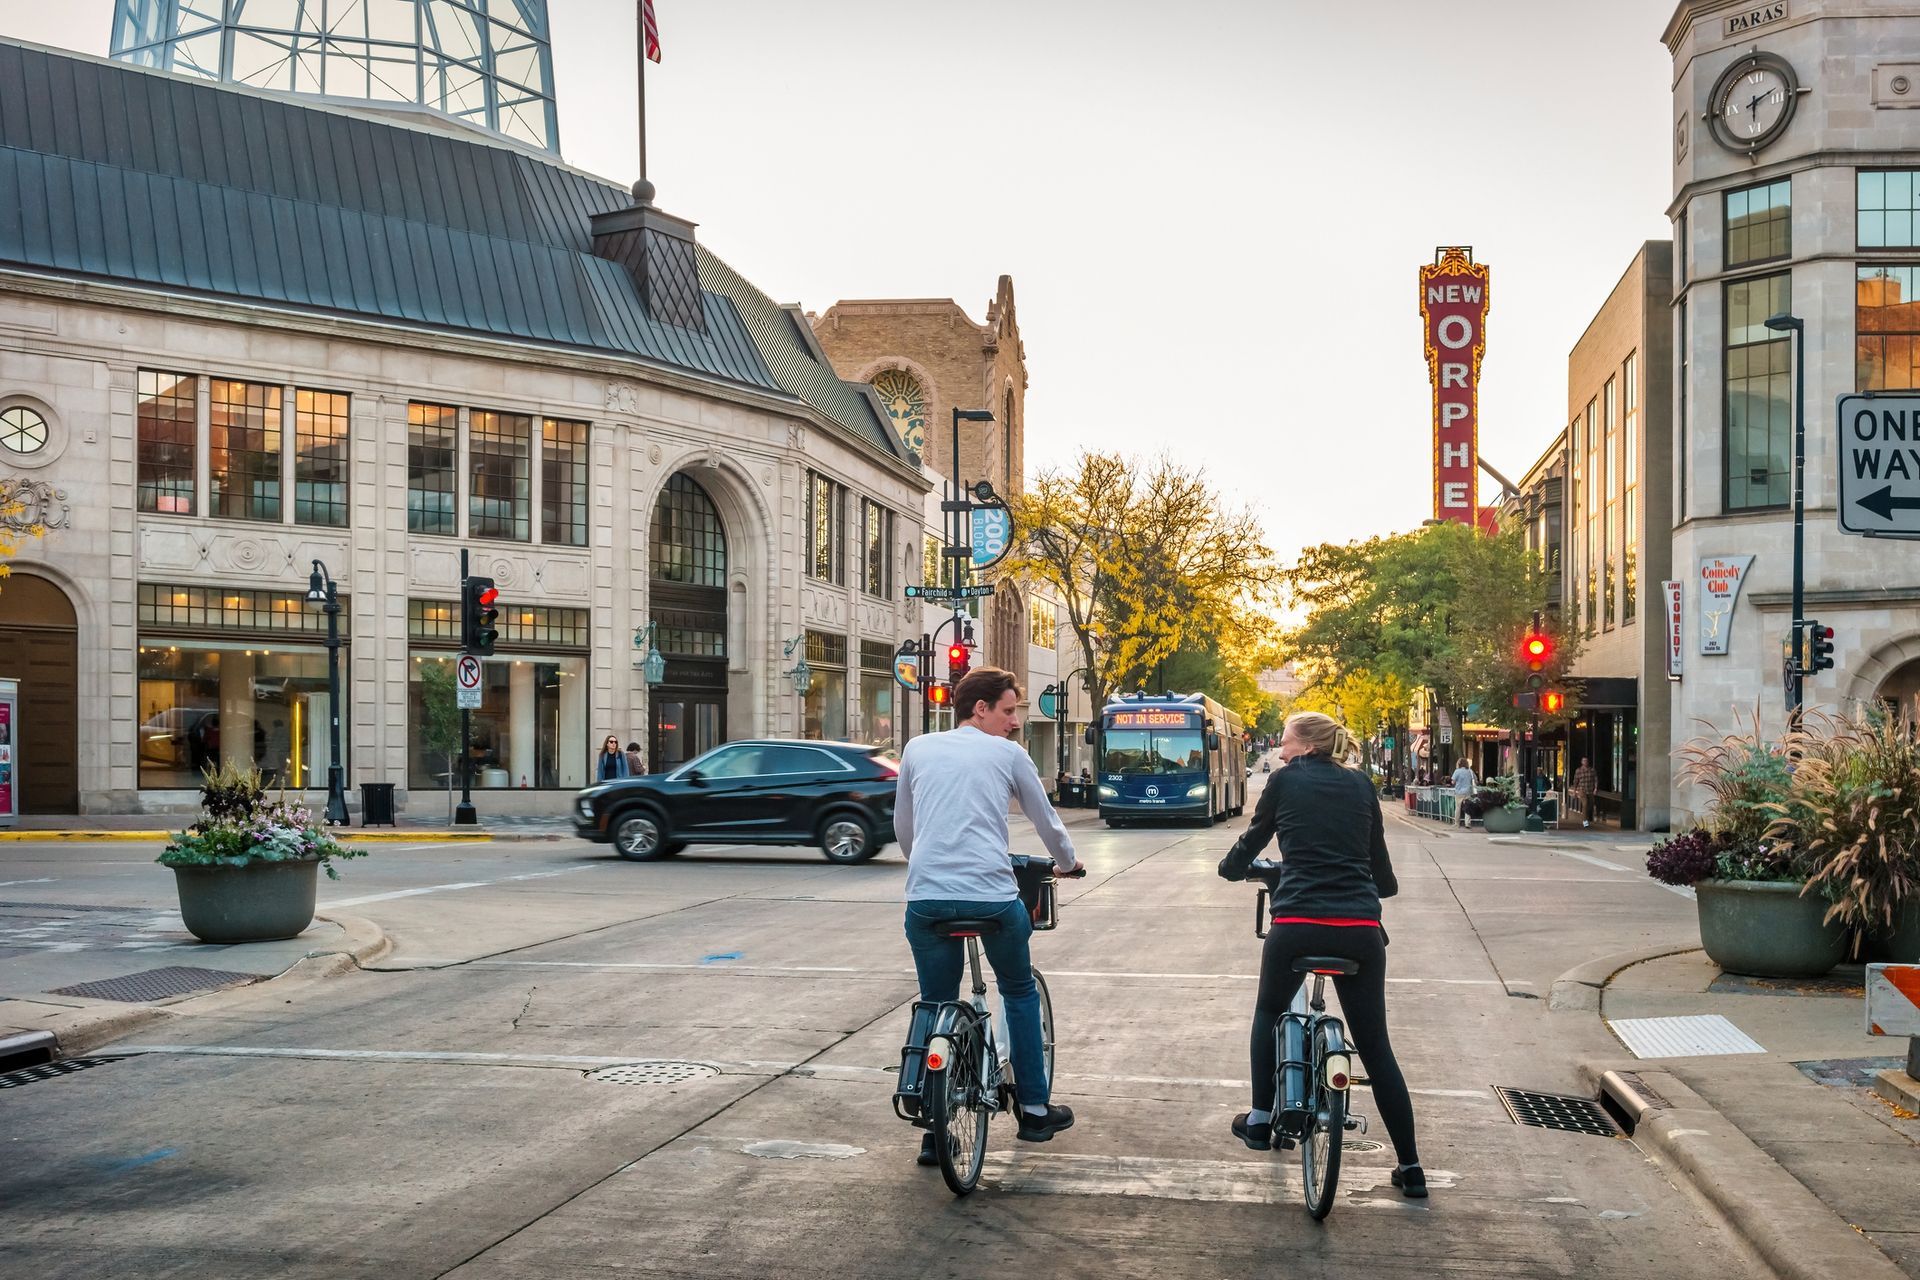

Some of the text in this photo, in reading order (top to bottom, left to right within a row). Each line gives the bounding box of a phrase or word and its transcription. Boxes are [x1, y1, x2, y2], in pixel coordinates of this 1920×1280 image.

[1729, 3, 1783, 33] PARAS
[1428, 285, 1481, 304] NEW
[1438, 315, 1472, 525] ORPHE
[973, 518, 984, 554] BLOCK
[984, 508, 1004, 554] 200
[1702, 565, 1740, 580] Comedy
[921, 587, 948, 597] Fairchild
[970, 586, 990, 597] Dayton
[1708, 580, 1728, 593] Club
[1673, 590, 1681, 657] COMEDY
[1116, 714, 1185, 724] NOT IN SERVICE
